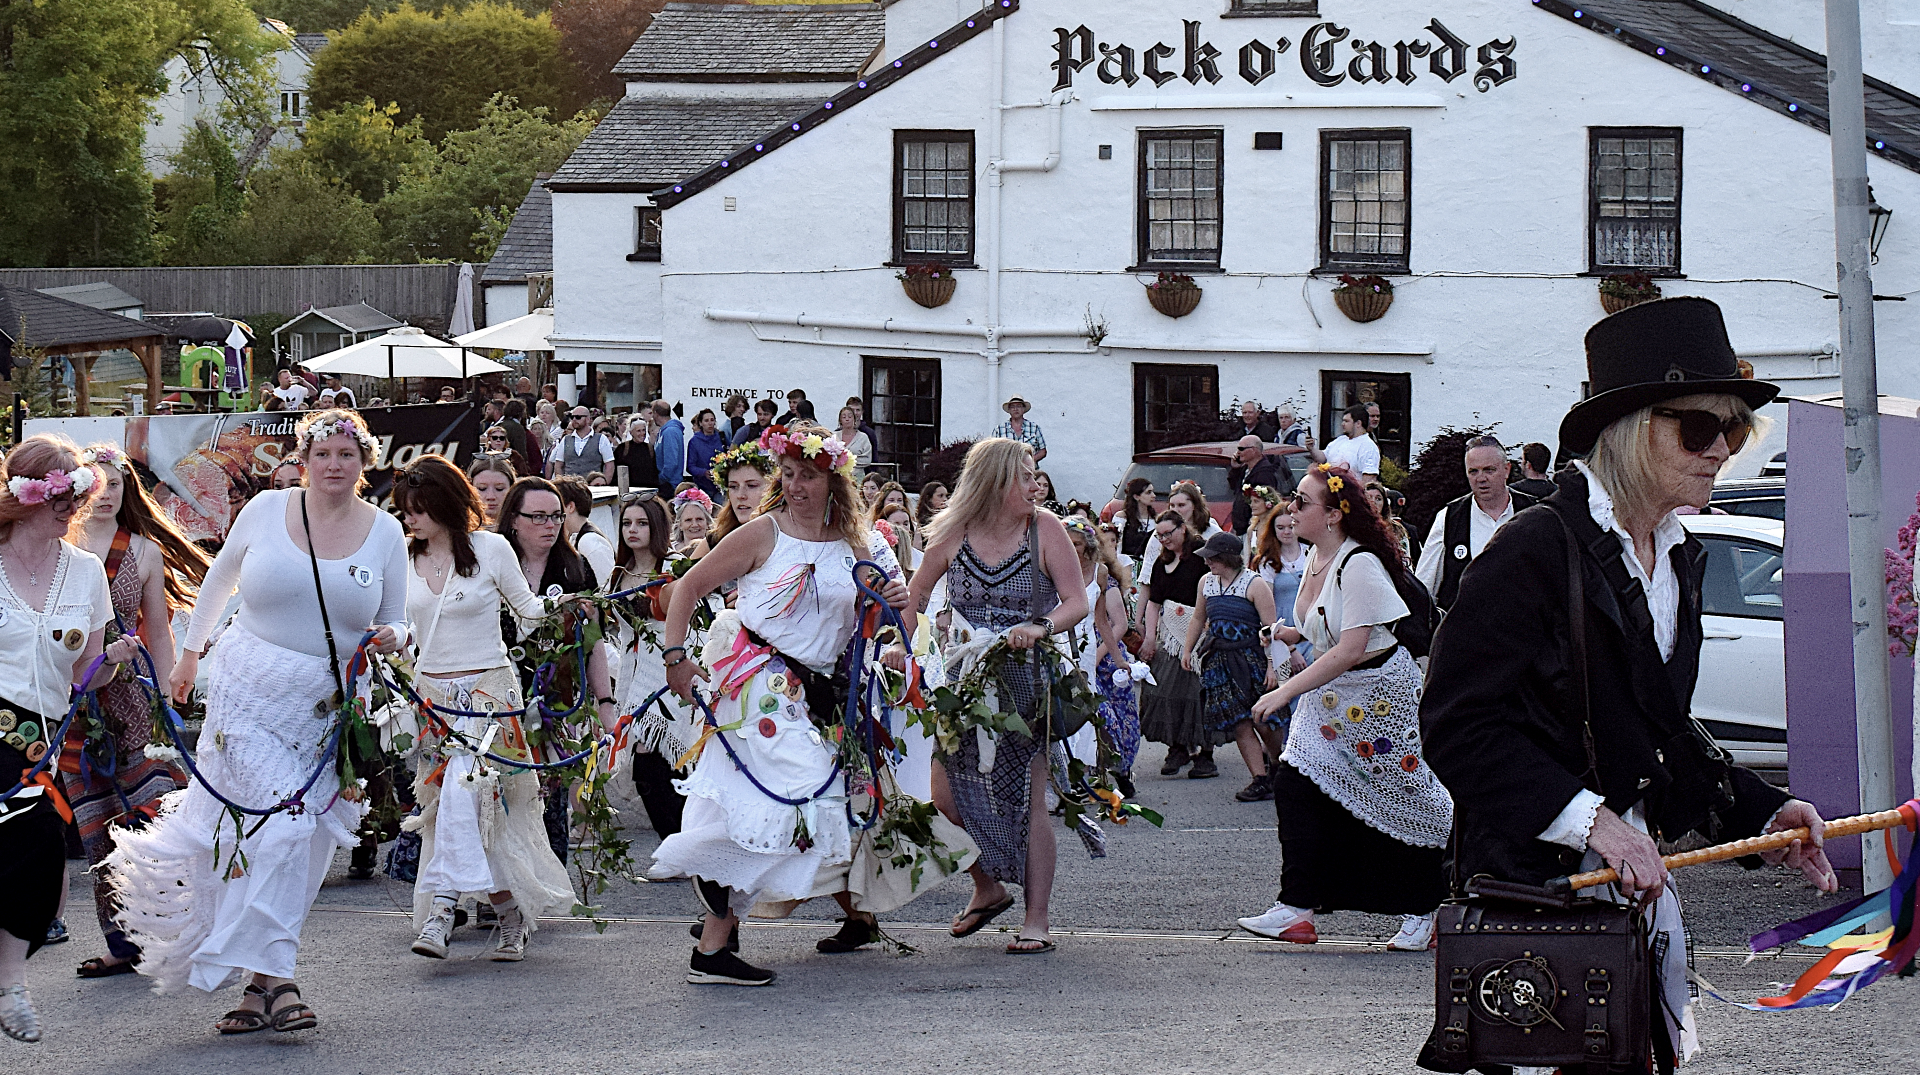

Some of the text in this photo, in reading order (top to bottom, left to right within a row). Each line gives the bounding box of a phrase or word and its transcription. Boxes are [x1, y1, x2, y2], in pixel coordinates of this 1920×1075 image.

[1050, 17, 1517, 93] Pack o' Cards
[691, 387, 784, 399] ENTRANCE TO
